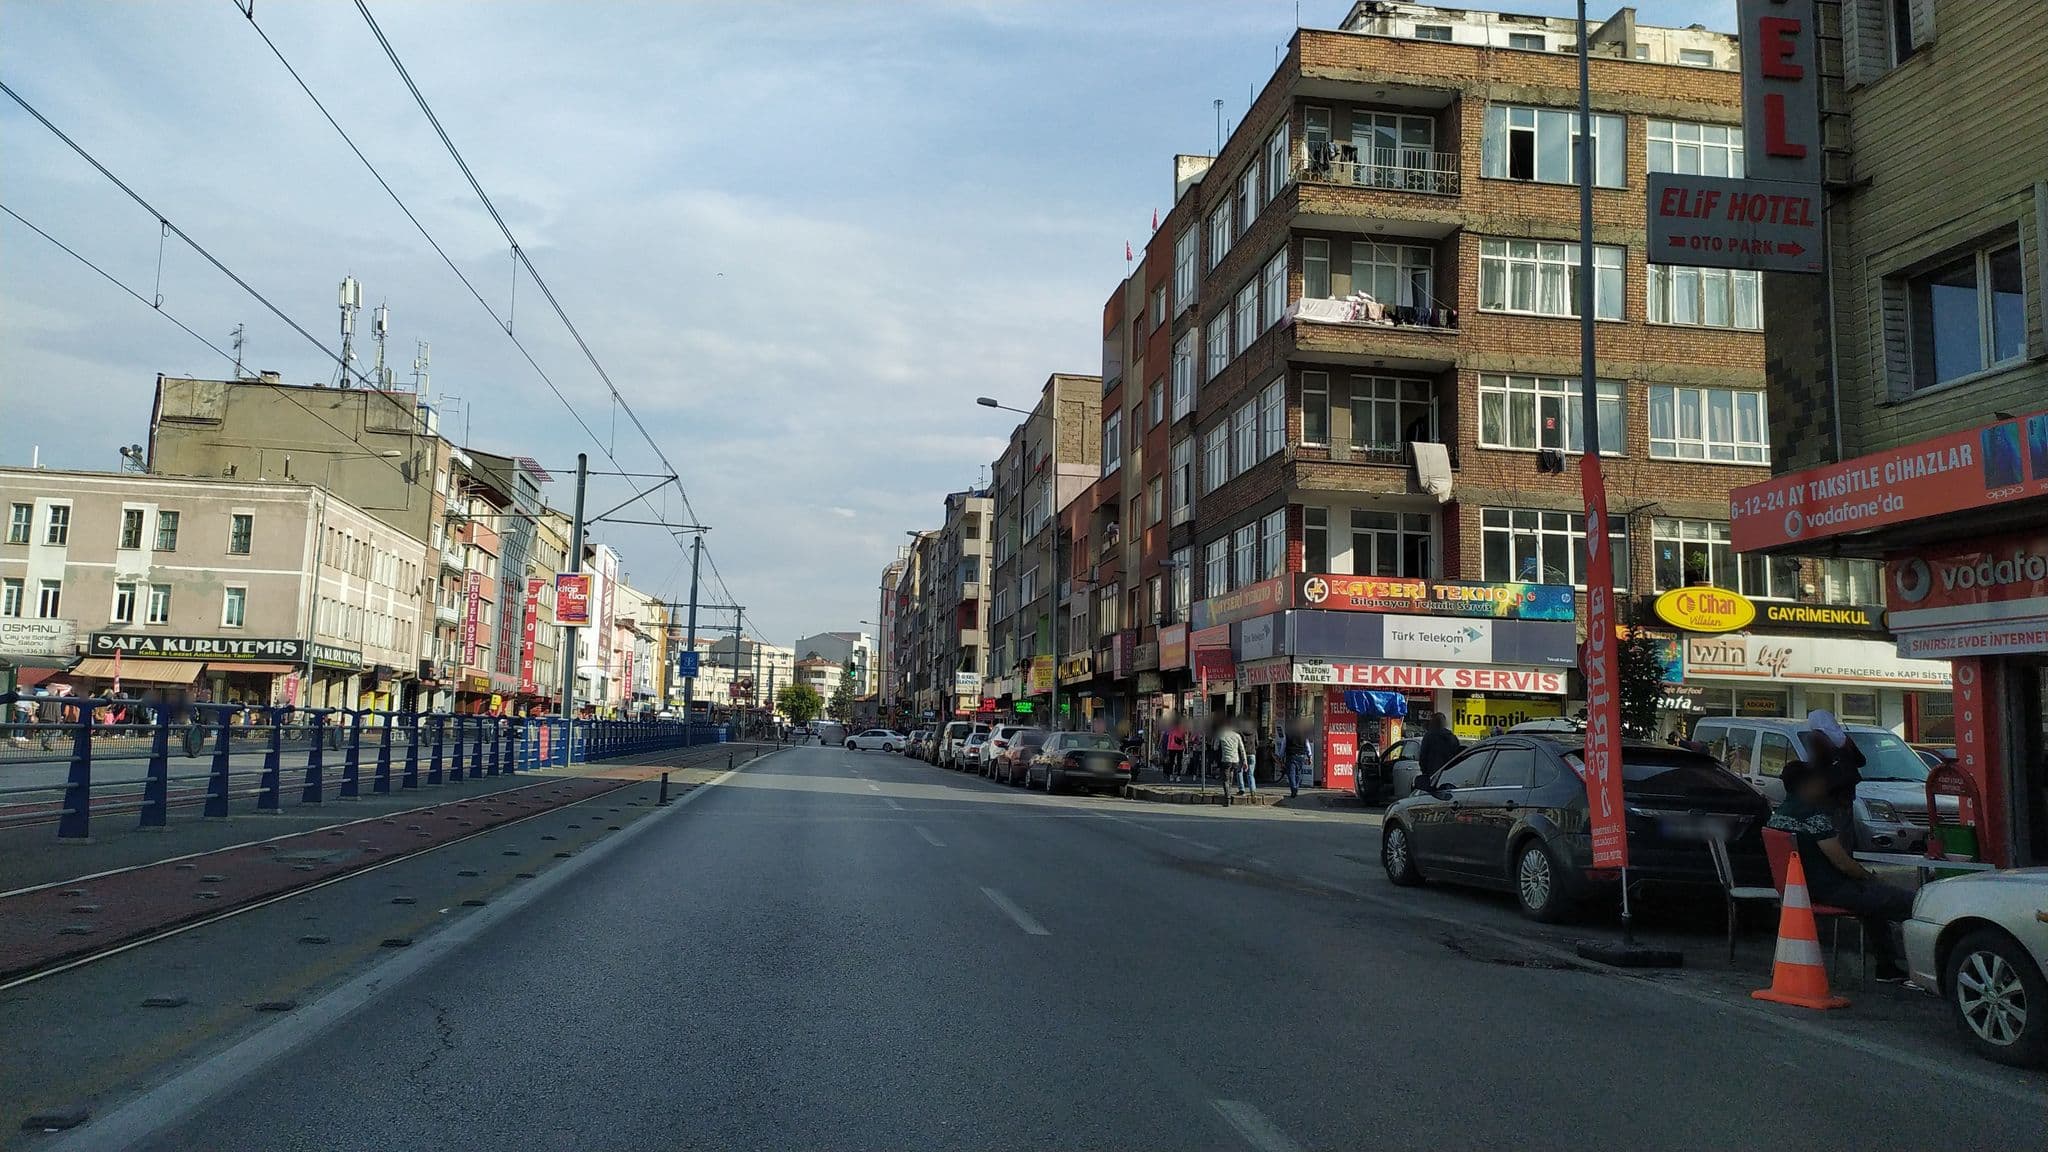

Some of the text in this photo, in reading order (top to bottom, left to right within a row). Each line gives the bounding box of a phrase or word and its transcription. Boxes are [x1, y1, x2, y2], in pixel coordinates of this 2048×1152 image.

[1759, 0, 1808, 159] EL
[1727, 192, 1815, 227] HOTEL
[1690, 235, 1774, 256] OTO PARK
[1731, 490, 1784, 520] 6-12-24
[1788, 484, 1805, 507] AY
[1941, 549, 2048, 591] vodafo
[1432, 585, 1510, 603] TEKNO
[1698, 593, 1737, 615] Cihan
[1457, 601, 1492, 612] Servis
[2, 623, 62, 634] OSMANLI
[466, 585, 479, 663] HOTEL ÖZBEK
[97, 635, 157, 651] SAFA
[523, 604, 536, 688] HOTEL
[1391, 630, 1464, 644] Türk Telekom
[1912, 637, 1957, 651] SINIRSIZ
[1957, 634, 1987, 648] EVDE
[1308, 658, 1324, 666] CEP
[1692, 640, 1746, 664] win
[1300, 674, 1331, 682] TABLET
[1301, 666, 1330, 674] TELEFONU
[1332, 663, 1445, 687] TEKNİK
[1455, 668, 1559, 692] SERVİS
[1814, 666, 1833, 675] PVC
[1838, 667, 1882, 677] PENCERE
[1898, 670, 1919, 679] KAPI
[1456, 708, 1534, 728] liramatik
